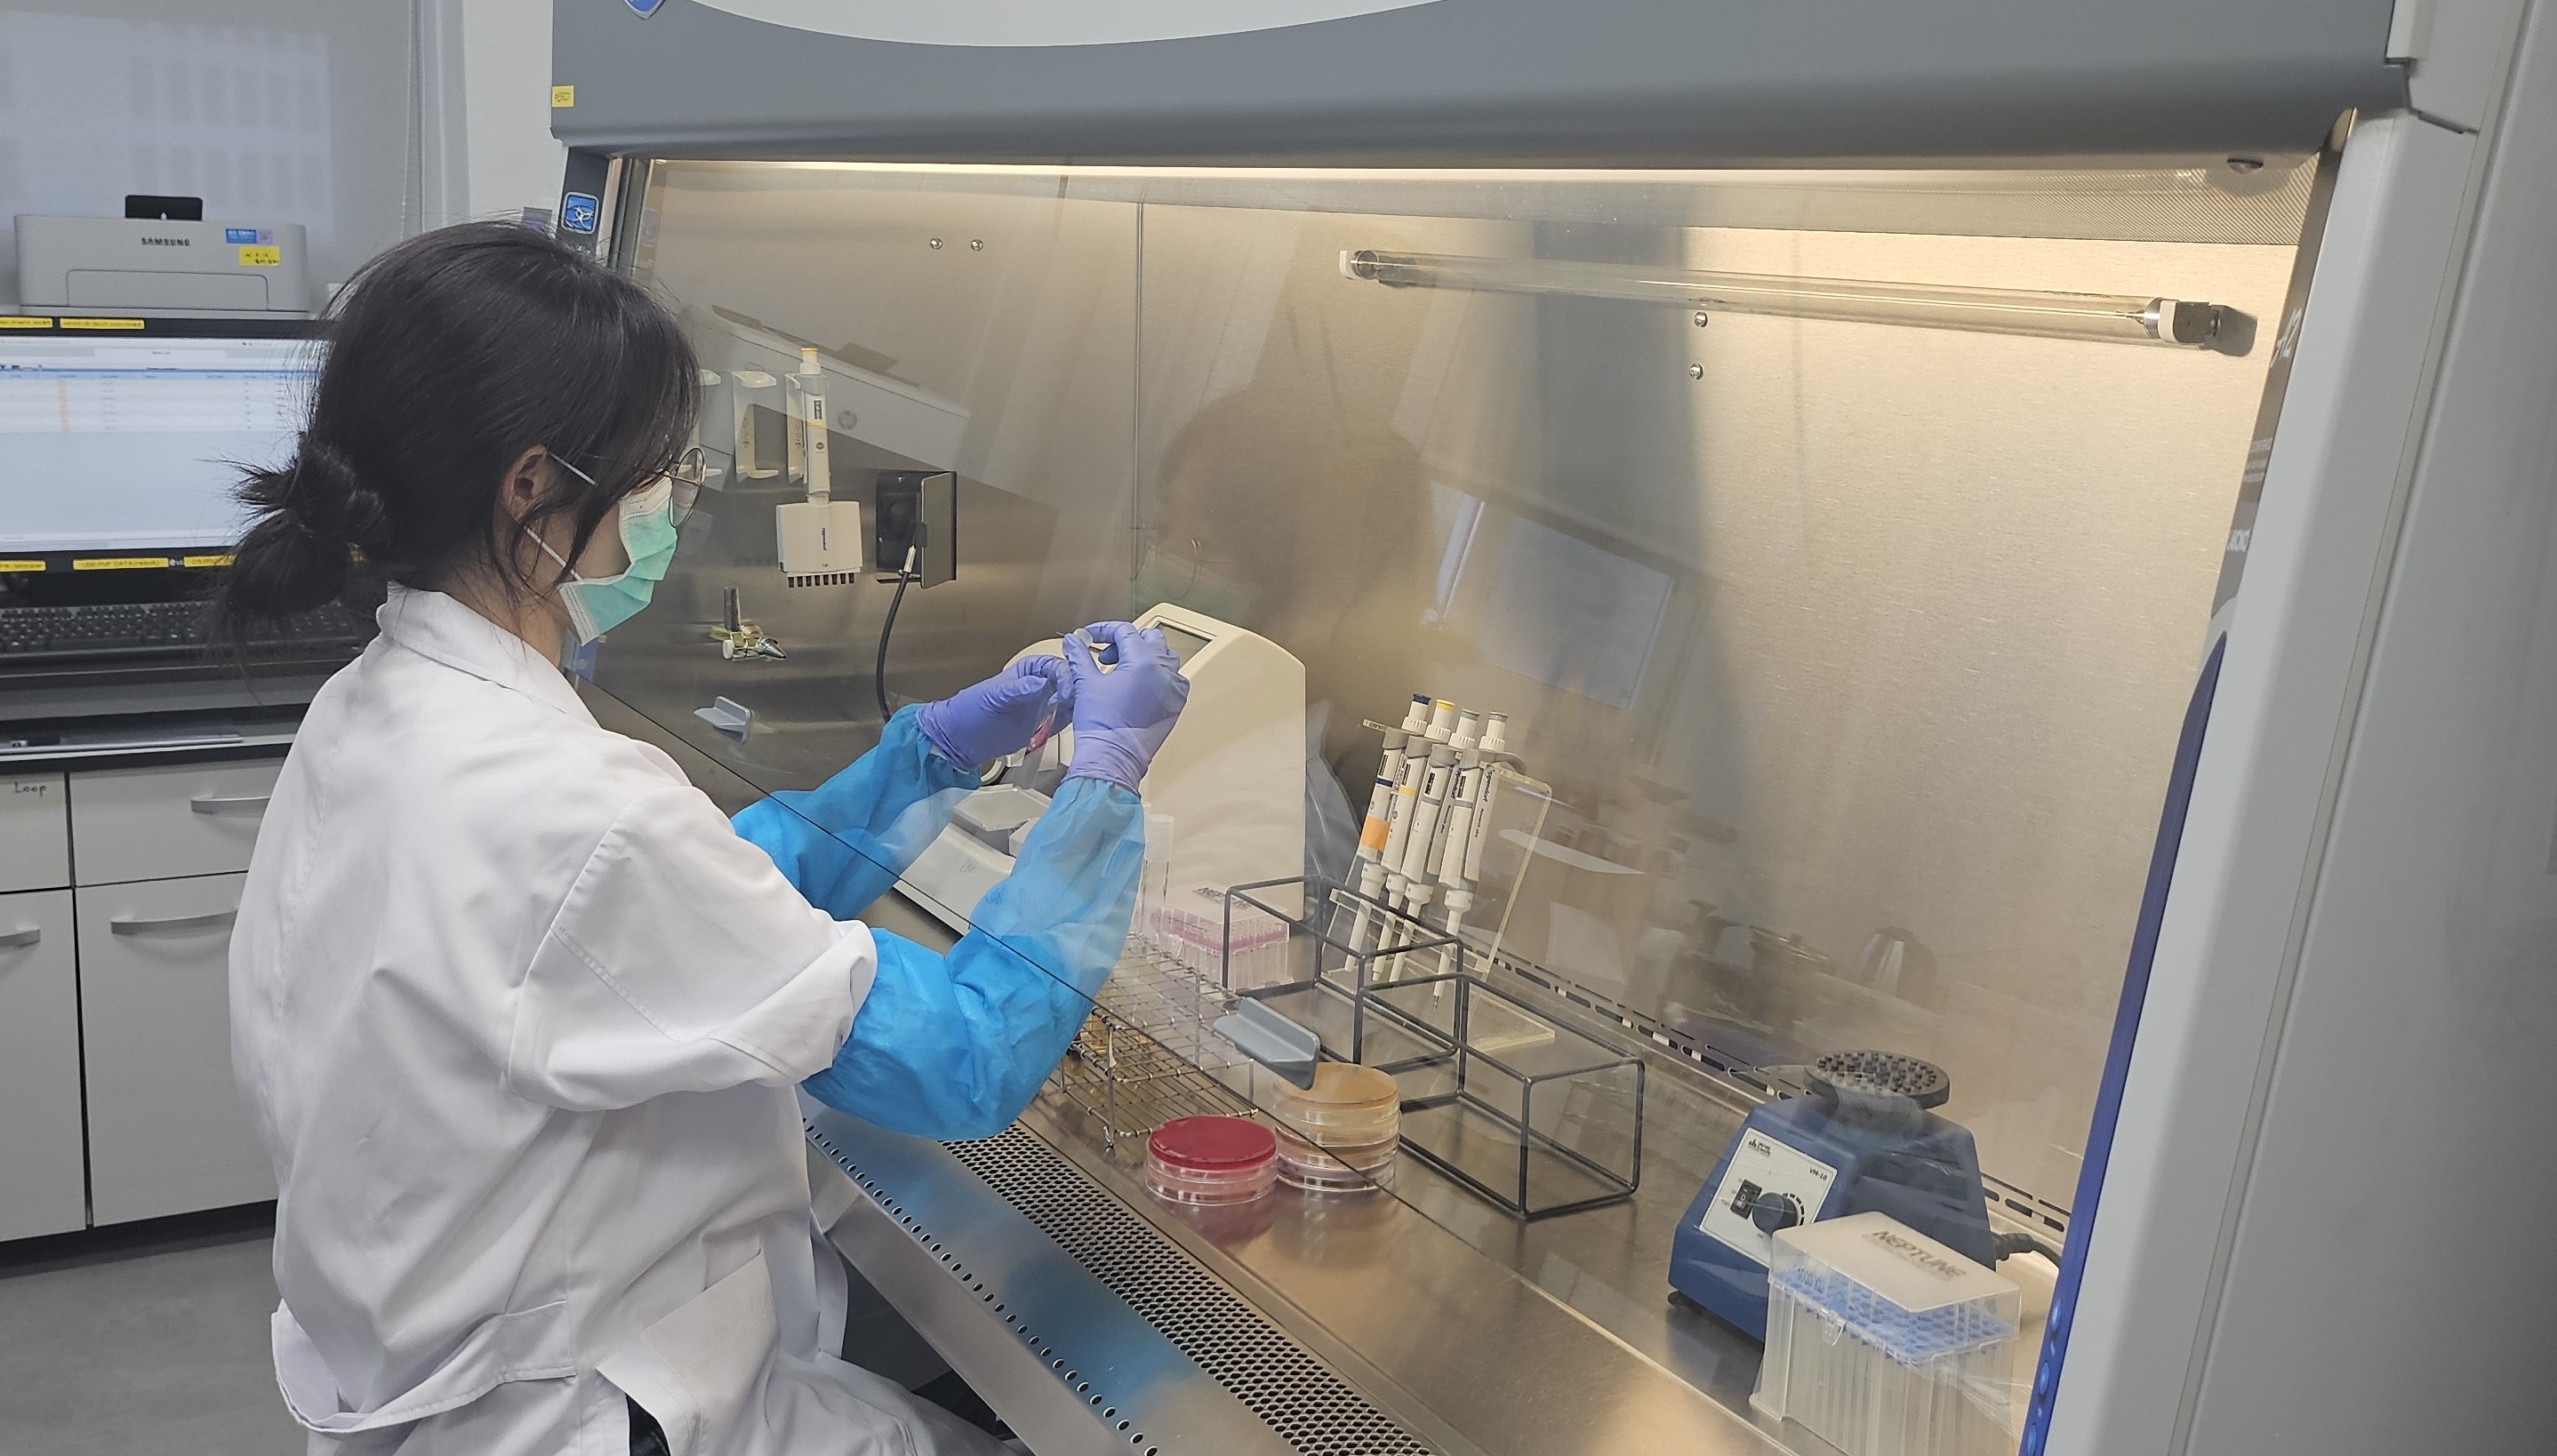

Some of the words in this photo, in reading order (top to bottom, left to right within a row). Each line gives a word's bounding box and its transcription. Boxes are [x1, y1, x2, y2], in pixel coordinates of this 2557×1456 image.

[141, 237, 190, 246] SAMSUNG
[14, 780, 47, 797] Loop
[1872, 1230, 1967, 1277] NEPTUNE
